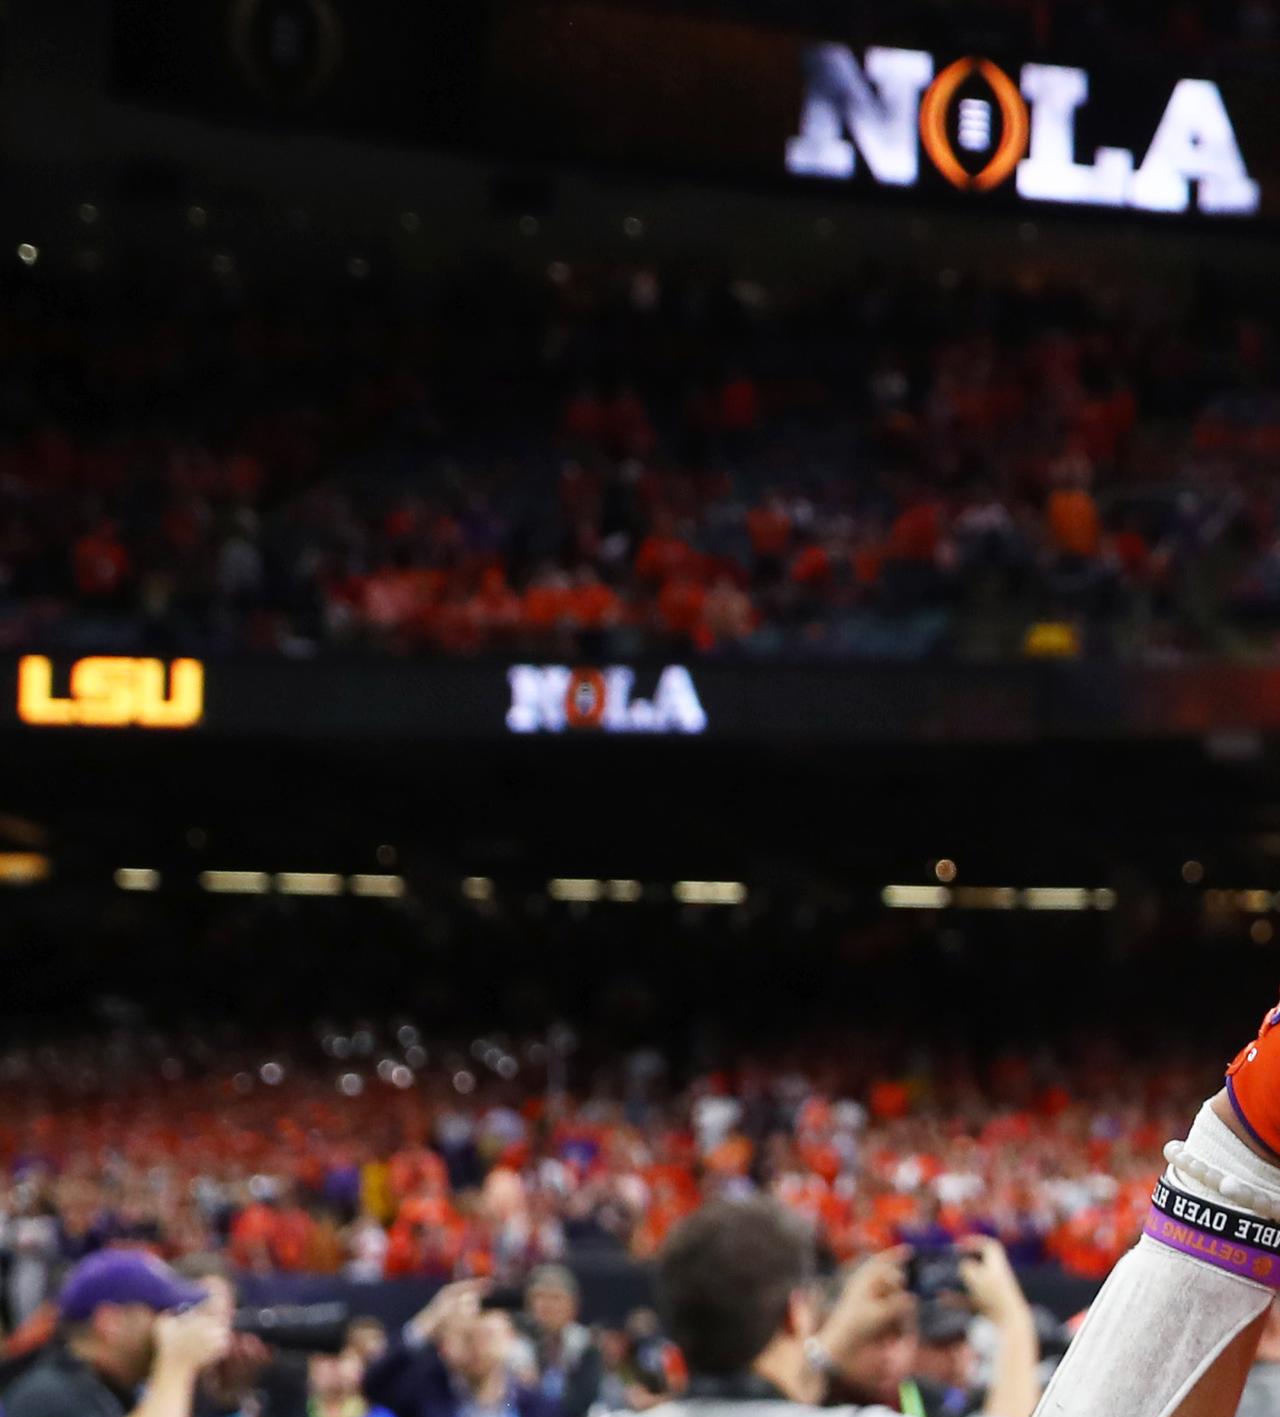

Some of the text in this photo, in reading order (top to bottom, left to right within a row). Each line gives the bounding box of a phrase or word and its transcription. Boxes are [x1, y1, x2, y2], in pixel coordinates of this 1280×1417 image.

[785, 40, 1260, 217] NOLA
[17, 654, 205, 728] LSU
[505, 663, 709, 735] NOLA
[1163, 1221, 1248, 1265] GETTING
[1172, 1194, 1228, 1232] OVER
